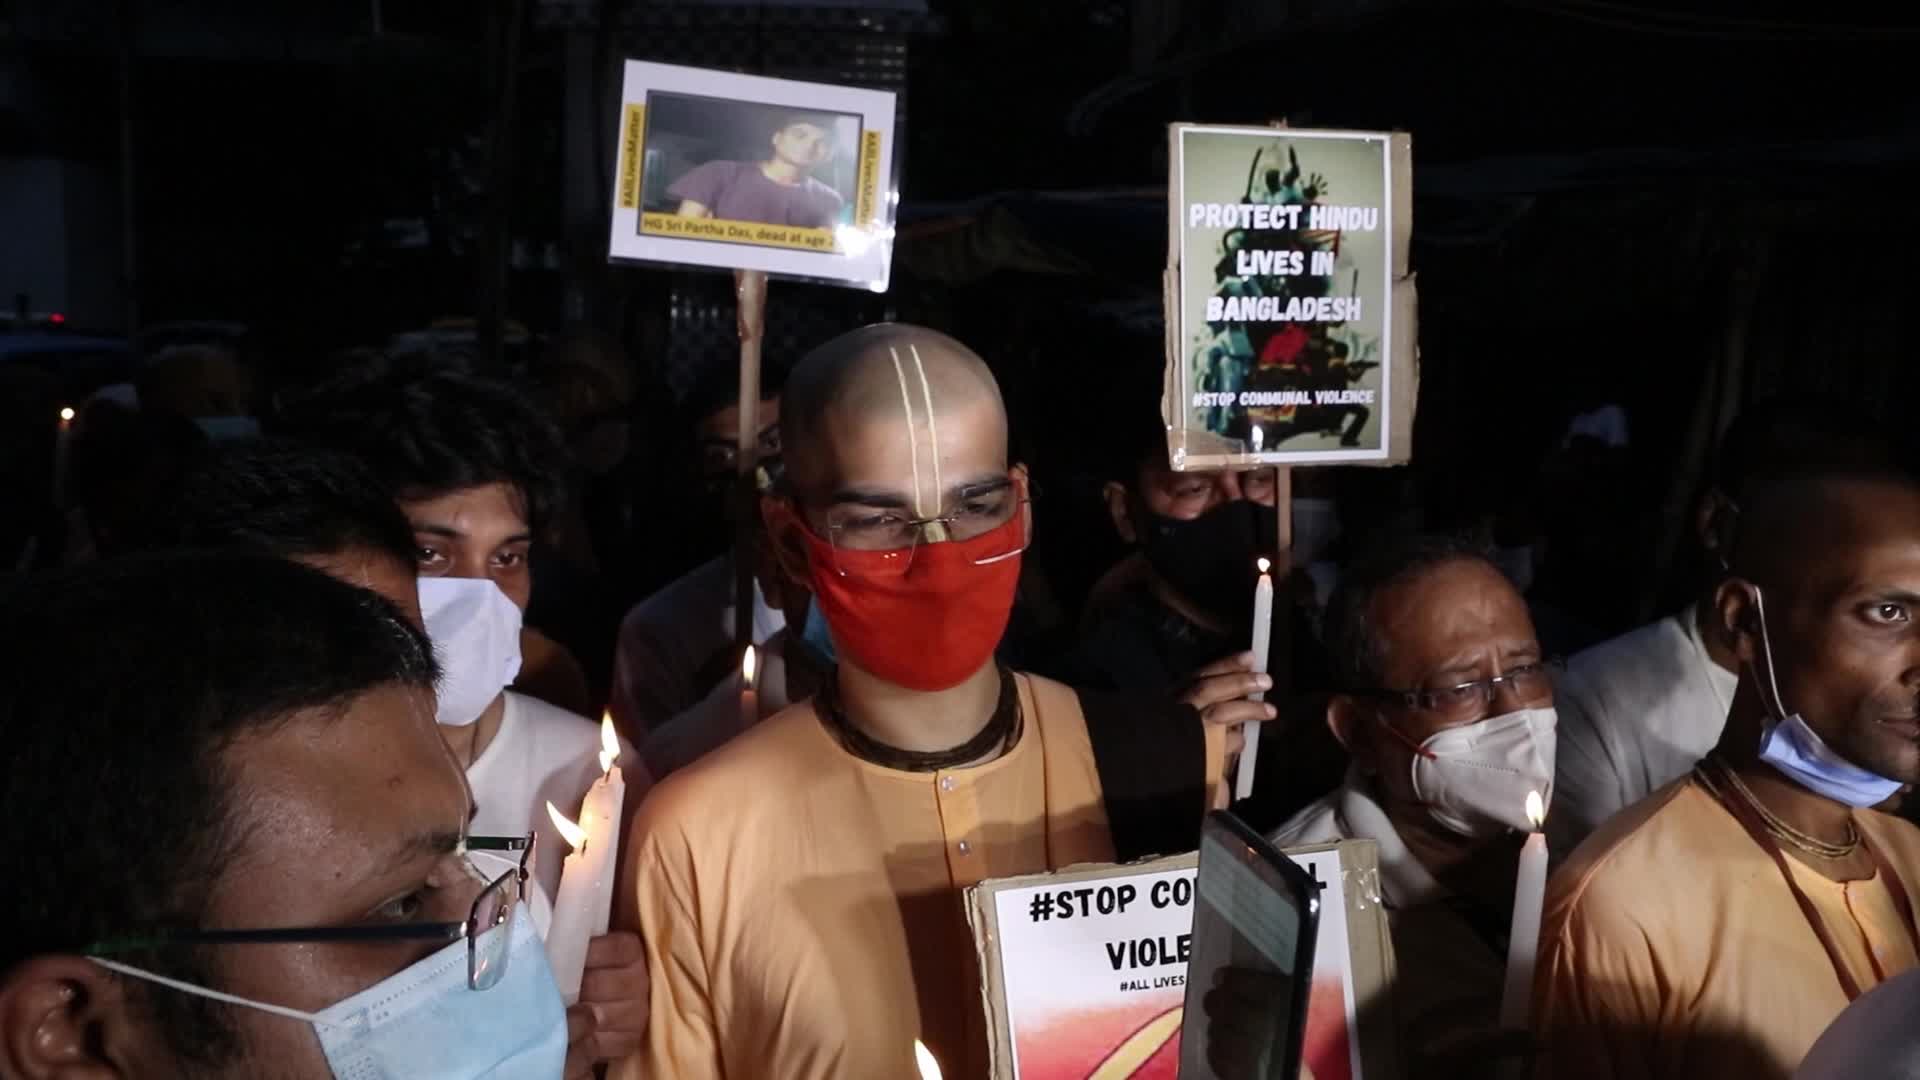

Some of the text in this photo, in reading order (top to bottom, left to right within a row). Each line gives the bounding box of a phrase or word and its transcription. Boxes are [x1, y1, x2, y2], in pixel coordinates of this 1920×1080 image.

[1190, 203, 1378, 231] PROTECT HINDU
[643, 218, 662, 229] HG
[665, 220, 682, 231] Sri
[685, 222, 724, 235] Partha
[727, 226, 752, 239] Das,
[756, 229, 786, 242] dead
[789, 233, 801, 243] at
[805, 235, 825, 248] age
[1236, 250, 1334, 276] LIVES IN
[1206, 296, 1362, 322] BANGLADESH
[1192, 389, 1375, 407] #STOP COMMUNAL VIOLENCE
[1029, 884, 1137, 922] #STOP
[1106, 933, 1192, 971] VIOLE
[1120, 976, 1185, 992] #ALL LIVES
